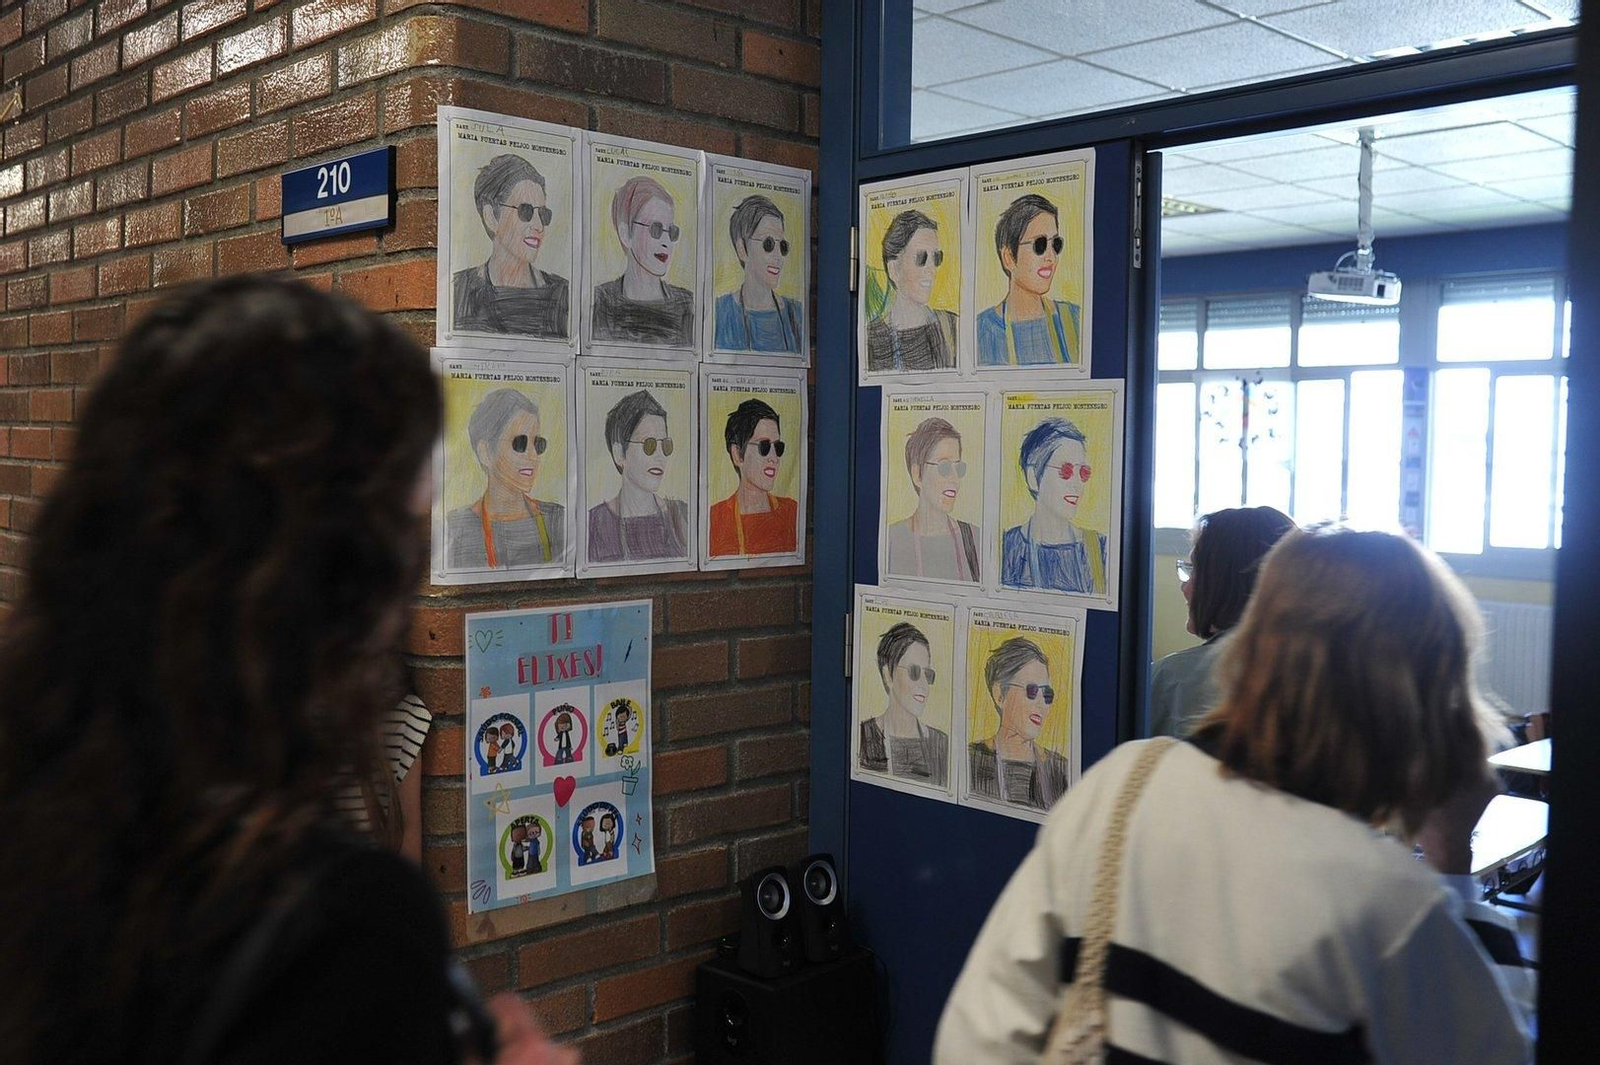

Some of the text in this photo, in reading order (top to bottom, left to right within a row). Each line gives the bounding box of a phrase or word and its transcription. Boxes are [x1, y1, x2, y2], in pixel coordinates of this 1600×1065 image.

[317, 161, 351, 199] 210
[518, 644, 603, 685] ELIXES!
[552, 703, 574, 716] PUÑO
[610, 698, 631, 709] BAILE
[510, 815, 540, 830] APERTA
